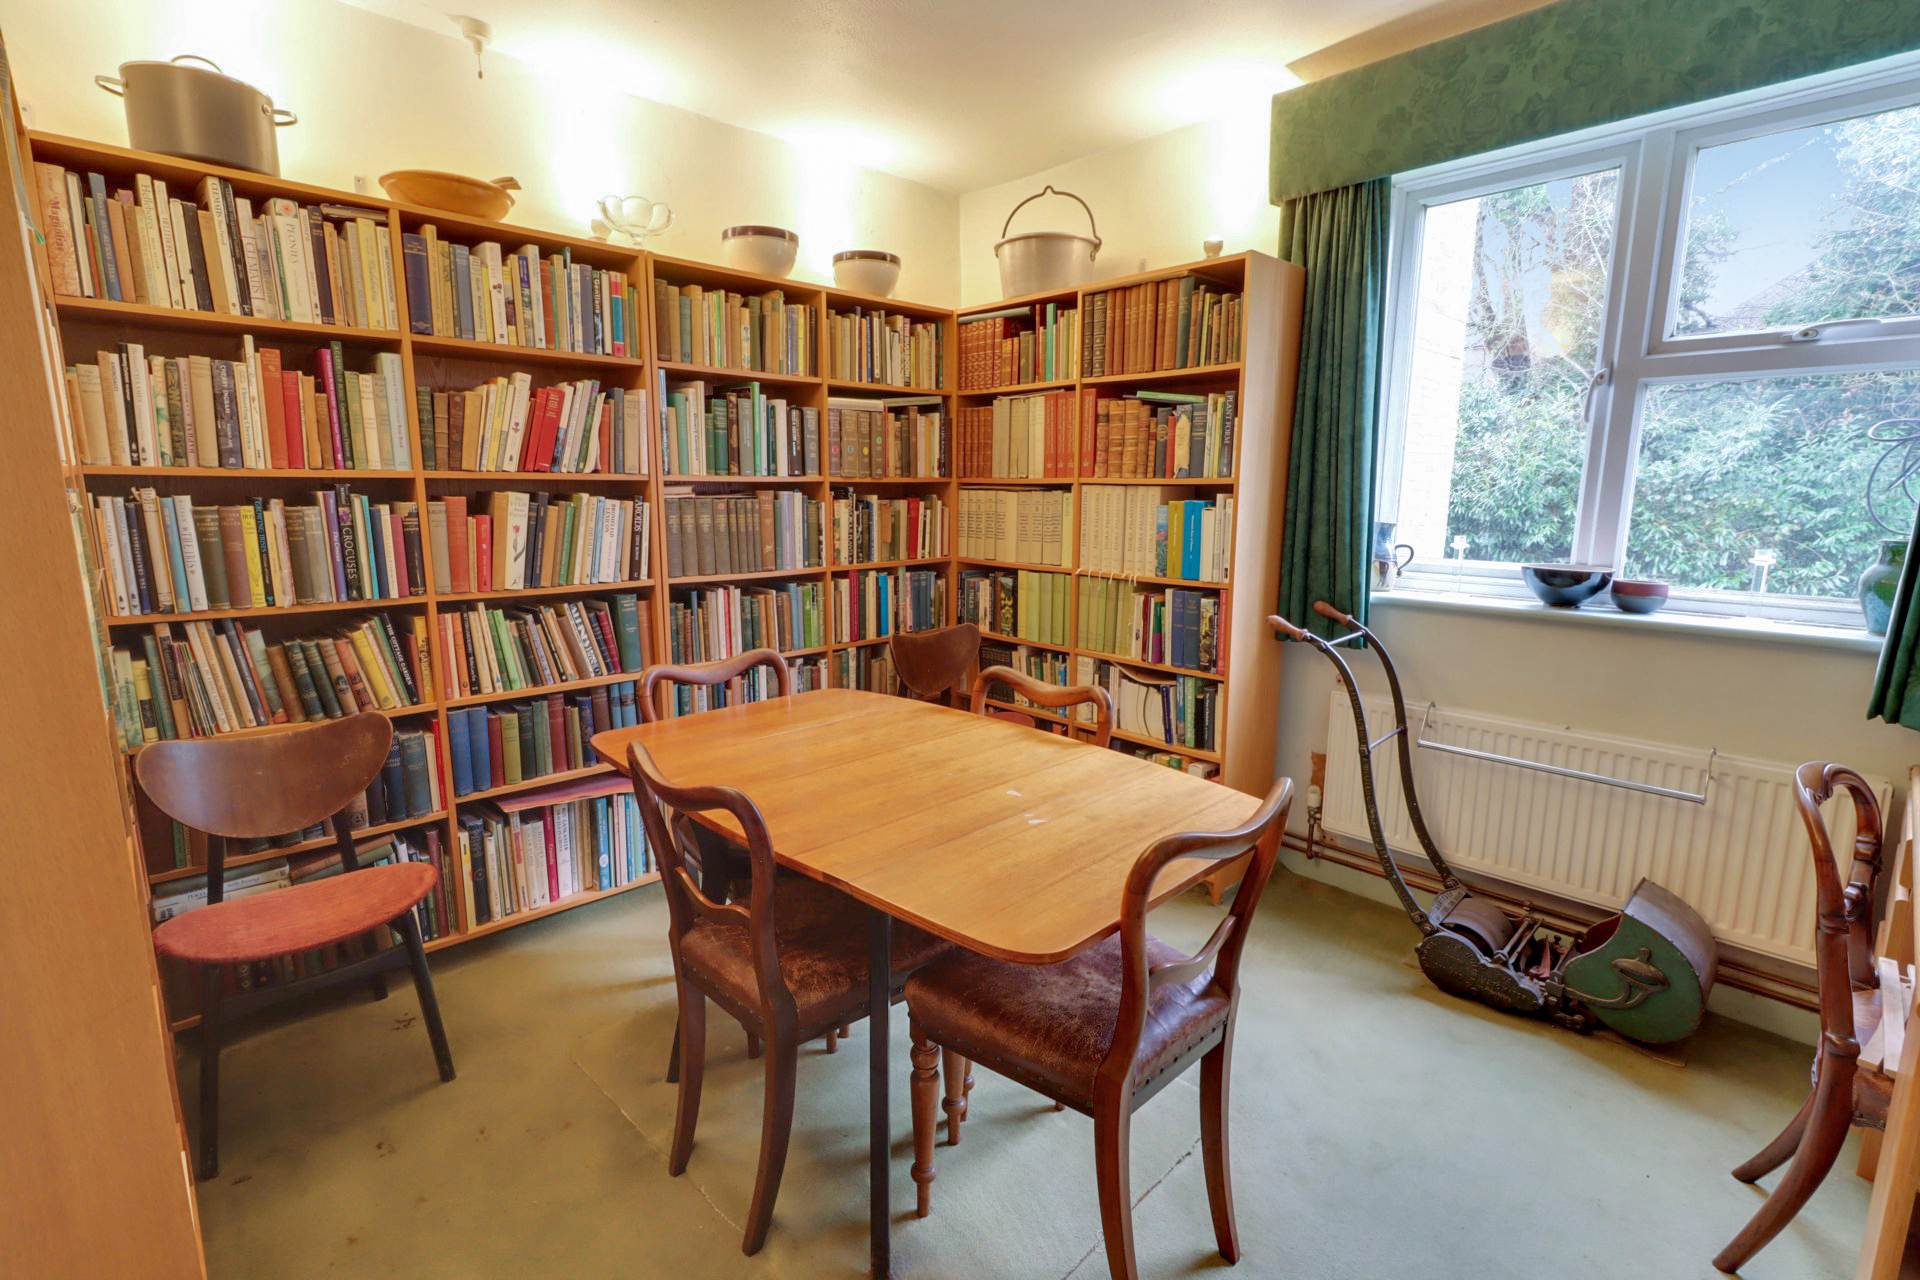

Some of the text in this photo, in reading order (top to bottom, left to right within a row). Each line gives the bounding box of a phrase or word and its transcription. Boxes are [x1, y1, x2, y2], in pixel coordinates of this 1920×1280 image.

[1224, 421, 1232, 443] FORM
[634, 499, 642, 531] AROIDS
[341, 526, 358, 579] CROCUSES
[385, 623, 413, 685] THE COTTAGE GARDEN
